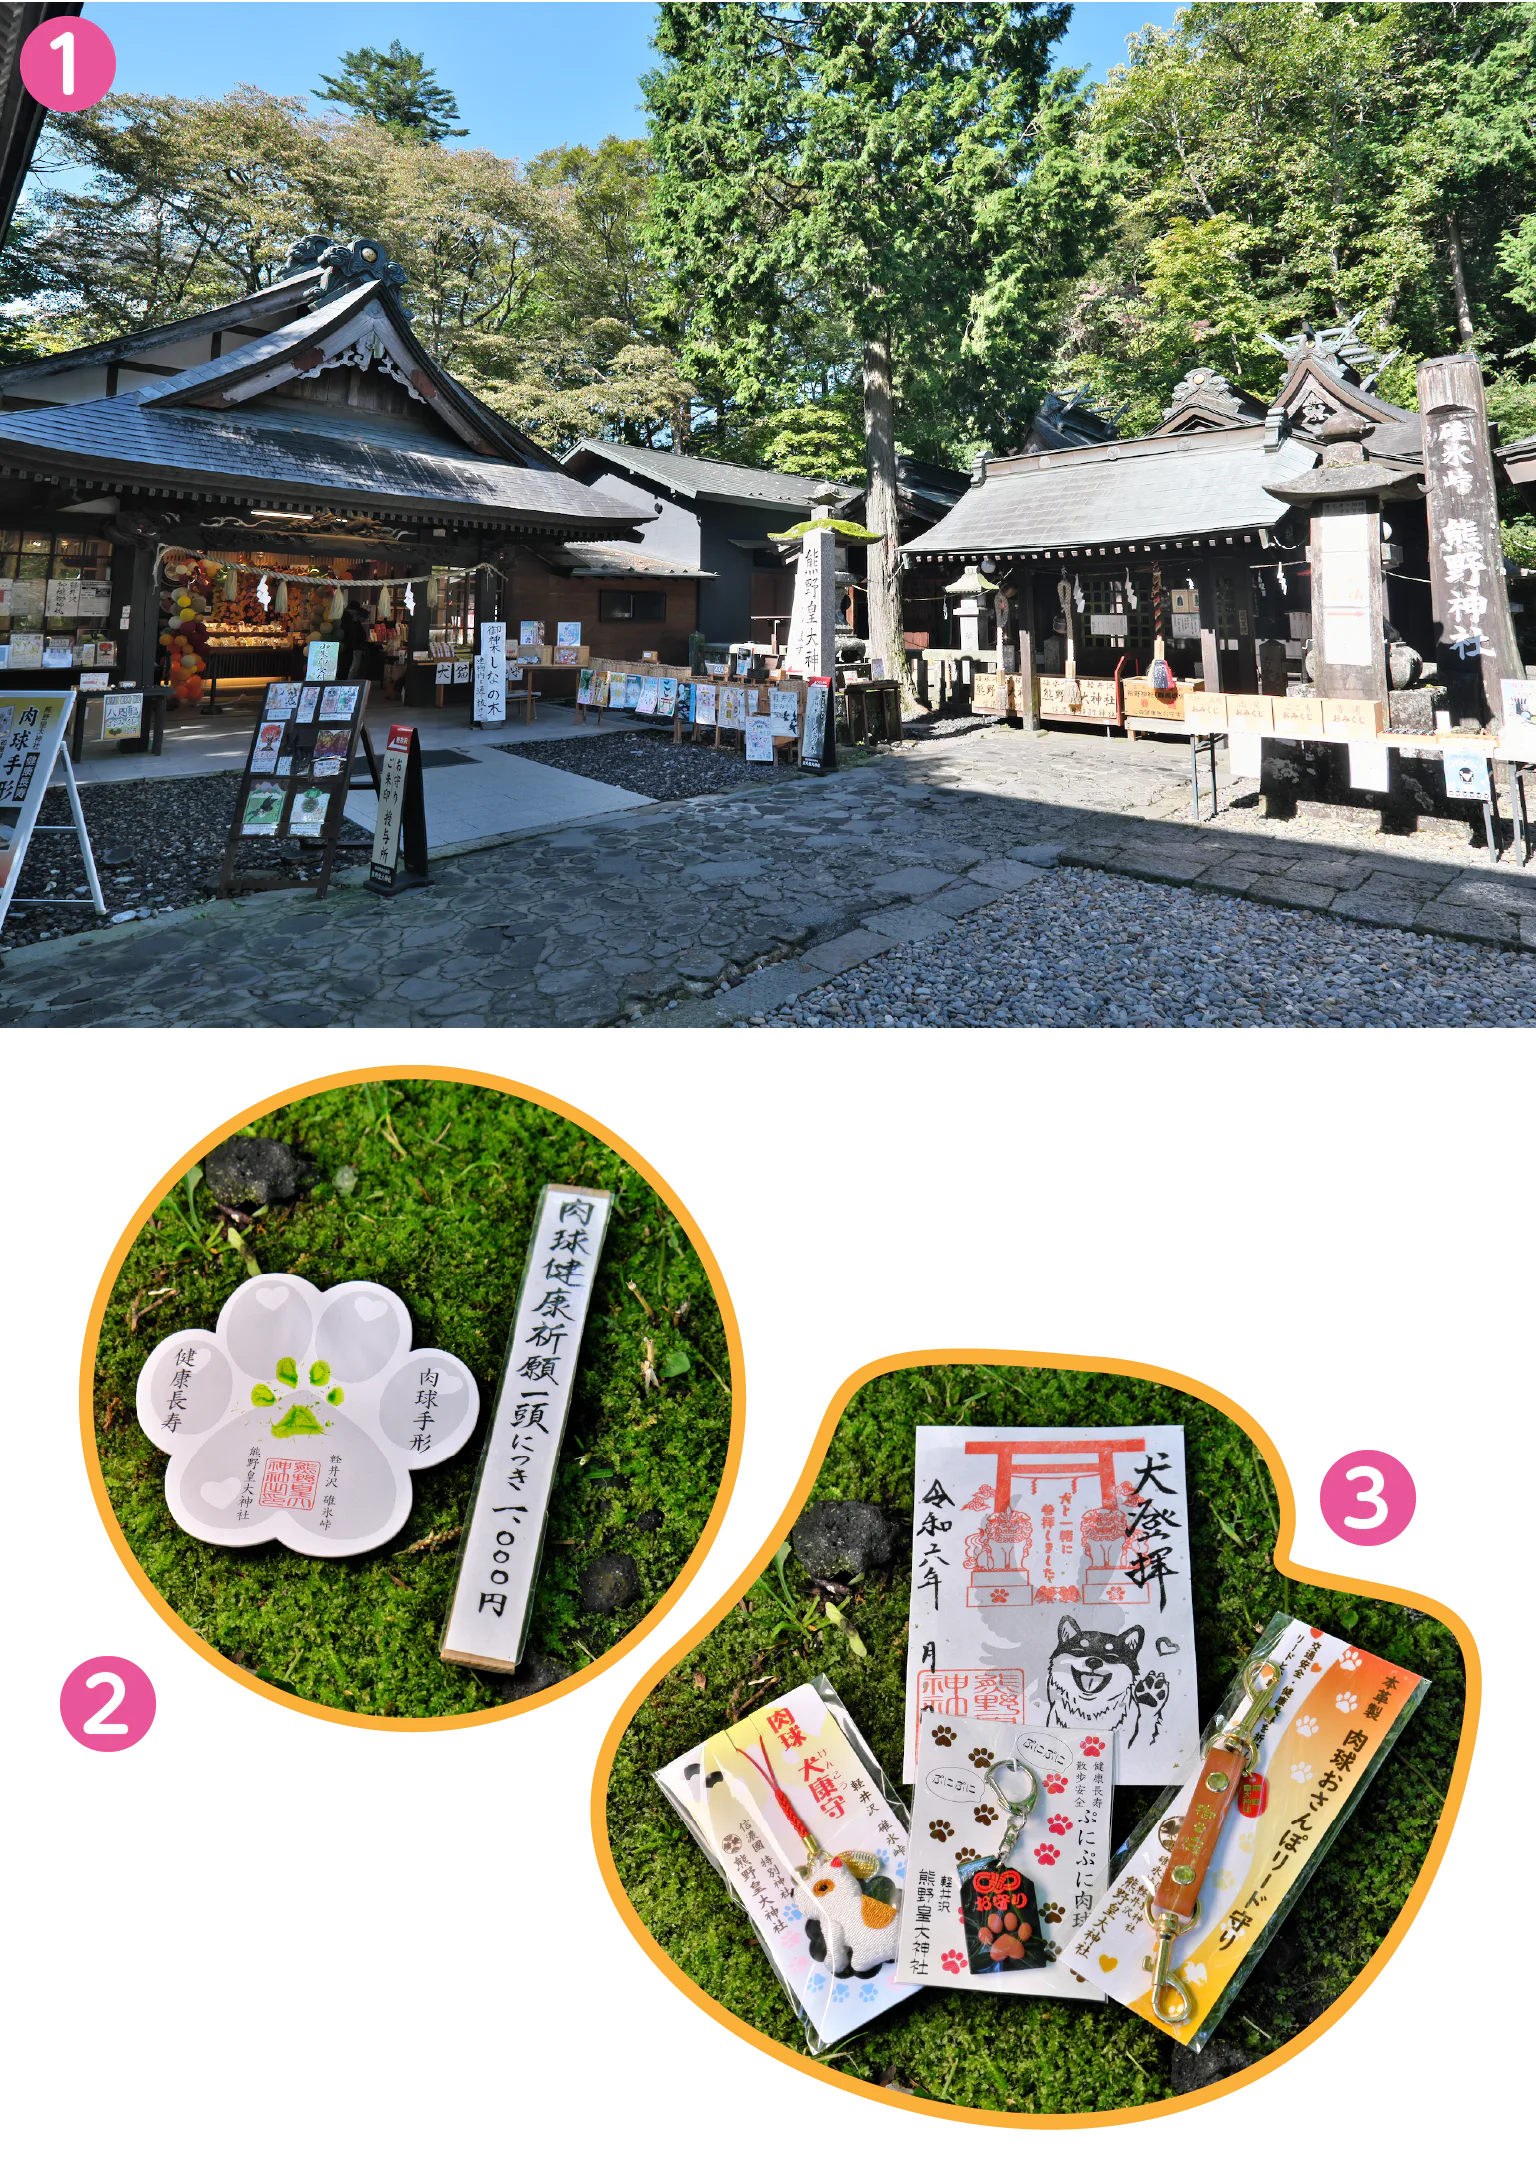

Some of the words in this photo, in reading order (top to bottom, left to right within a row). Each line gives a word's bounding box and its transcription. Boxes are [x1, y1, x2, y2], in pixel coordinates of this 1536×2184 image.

[1439, 421, 1474, 496] 碓氷峠
[1441, 518, 1497, 660] 熊野神社
[437, 664, 450, 679] 犬
[1282, 711, 1313, 721] おみくじ
[1332, 714, 1366, 725] おみくじ
[0, 706, 38, 801] 肉球手形
[379, 810, 393, 864] 授与所
[161, 1348, 197, 1434] 健康長寿
[409, 1367, 439, 1455] 肉球手形
[236, 1446, 261, 1520] 熊野皇大神社
[325, 1454, 342, 1488] 軽井沢
[916, 1478, 955, 1611] 令和六年
[1041, 1503, 1055, 1582] 参拝しました
[1059, 1492, 1073, 1554] 犬と一緒に
[922, 1641, 936, 1673] 月
[1362, 1676, 1400, 1722] 本革製
[767, 1707, 807, 1752] 肉球
[798, 1756, 846, 1819] 犬康守
[817, 1748, 849, 1791] けんこう
[931, 1774, 977, 1794] ぷにぷに
[1022, 1738, 1067, 1766] ぷにぷに
[1073, 1760, 1088, 1809] 散歩安全
[1092, 1761, 1105, 1809] 健康長寿
[850, 1778, 880, 1816] 軽井沢
[877, 1819, 906, 1857] 碓氷峠
[1218, 1728, 1370, 1952] 肉球おさんぽリード守り
[740, 1820, 765, 1852] 信濃國
[760, 1854, 793, 1899] 特別神社
[733, 1853, 789, 1935] 熊野皇大神社
[909, 1868, 936, 1975] 熊野皇大神社
[938, 1875, 953, 1913] 軽井沢
[974, 1892, 1028, 1913] お守り
[1074, 1876, 1139, 1959] 熊野皇大神社
